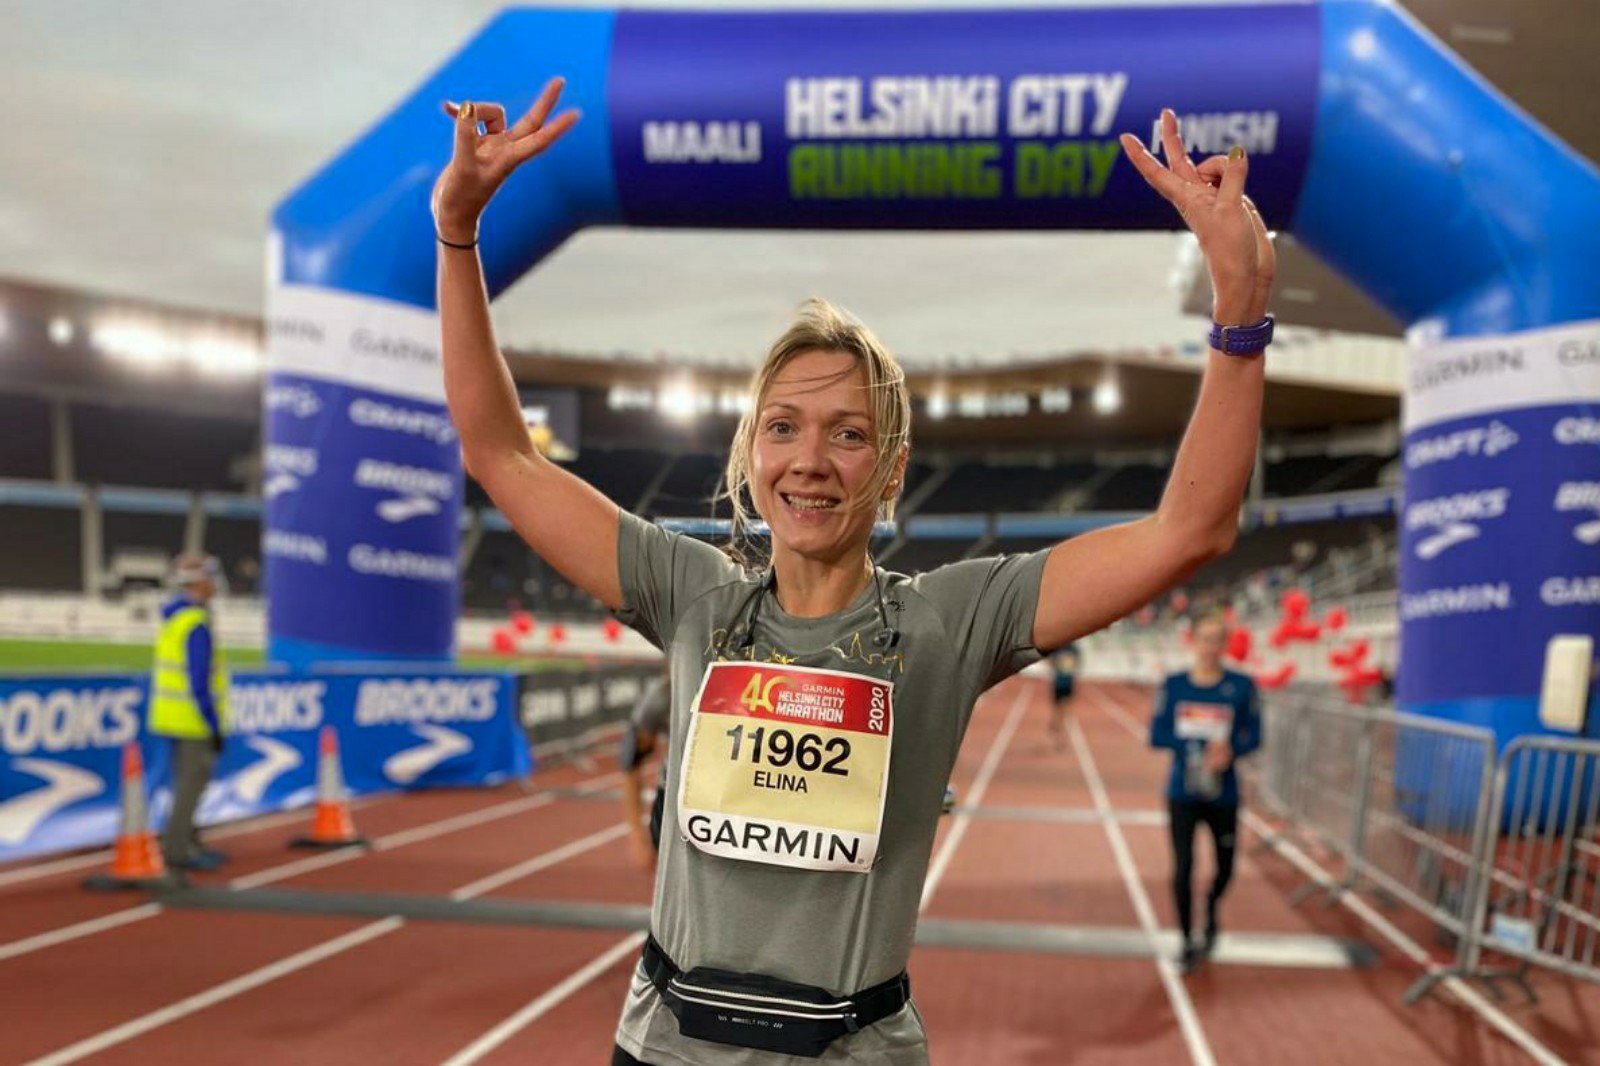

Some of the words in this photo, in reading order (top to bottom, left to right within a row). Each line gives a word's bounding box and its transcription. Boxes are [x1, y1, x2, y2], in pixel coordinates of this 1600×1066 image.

[643, 121, 761, 163] MAALI
[1015, 142, 1120, 198] DAY
[355, 679, 498, 726] BROOKS
[778, 691, 821, 708] HELSINKI
[801, 683, 845, 697] GARMIN
[868, 686, 885, 732] 2020
[776, 702, 844, 724] MARATHON
[726, 724, 852, 777] 11962
[753, 770, 808, 793] ELINA
[687, 814, 860, 864] GARMIN
